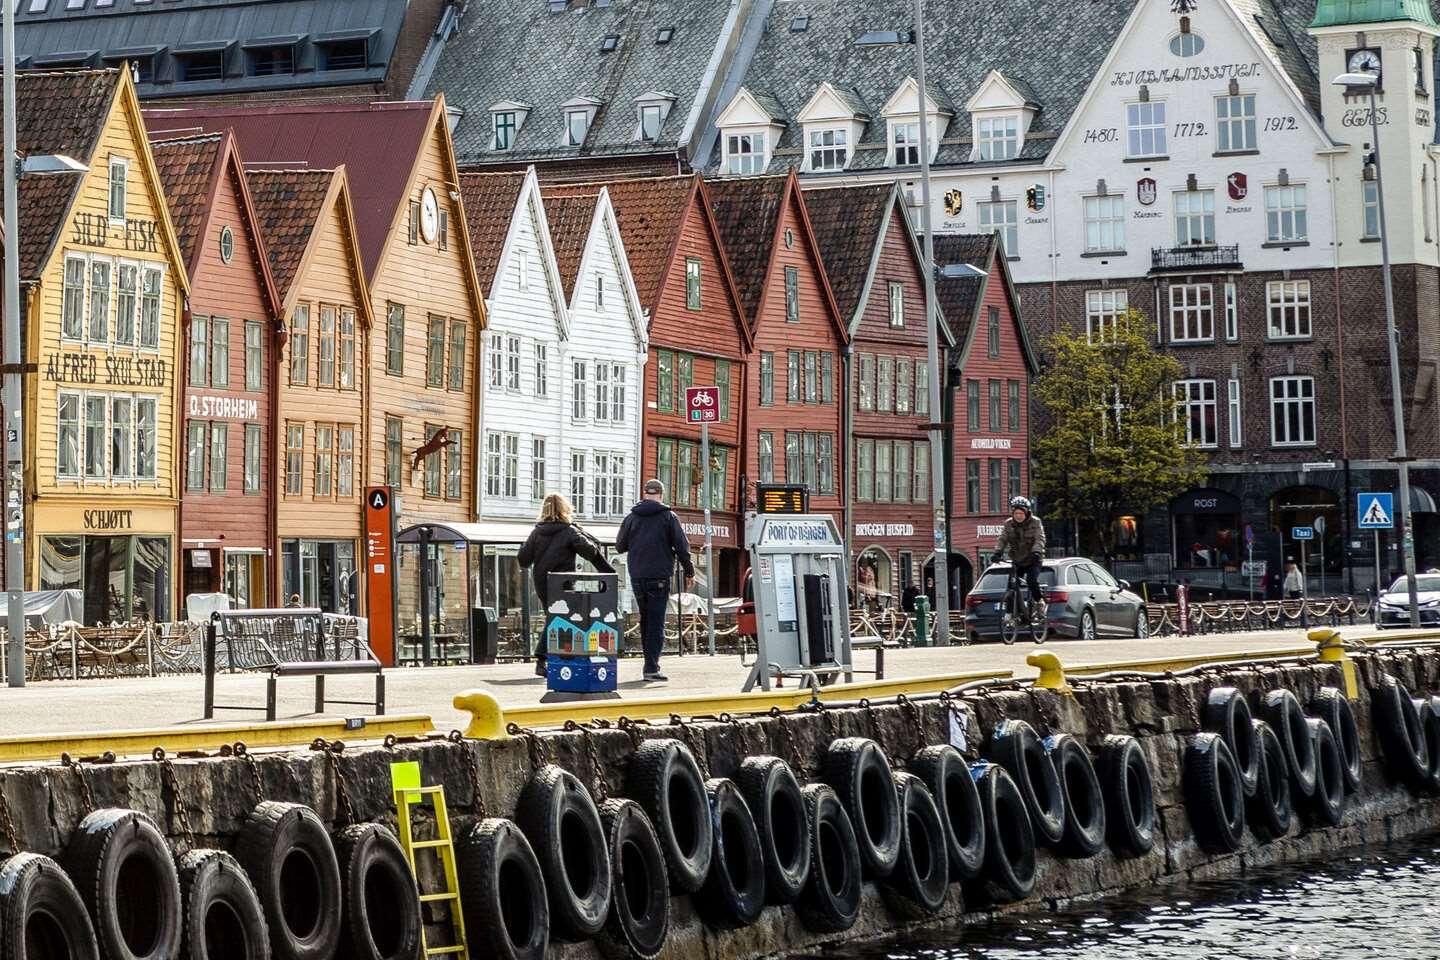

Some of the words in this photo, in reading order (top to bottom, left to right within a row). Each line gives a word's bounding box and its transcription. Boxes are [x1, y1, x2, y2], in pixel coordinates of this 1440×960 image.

[1174, 122, 1208, 138] 1712.
[1264, 116, 1299, 131] 1912.
[73, 211, 106, 247] SILD
[125, 219, 158, 253] FISK
[46, 352, 97, 384] ALFRED
[105, 355, 166, 388] SKULSTAD
[373, 493, 384, 507] A
[84, 509, 133, 529] SCHJØTT
[768, 525, 787, 540] PORT
[788, 525, 798, 540] OF
[799, 526, 827, 540] BERGEN
[855, 523, 885, 536] BRYGGEN
[1296, 528, 1311, 538] Taxi
